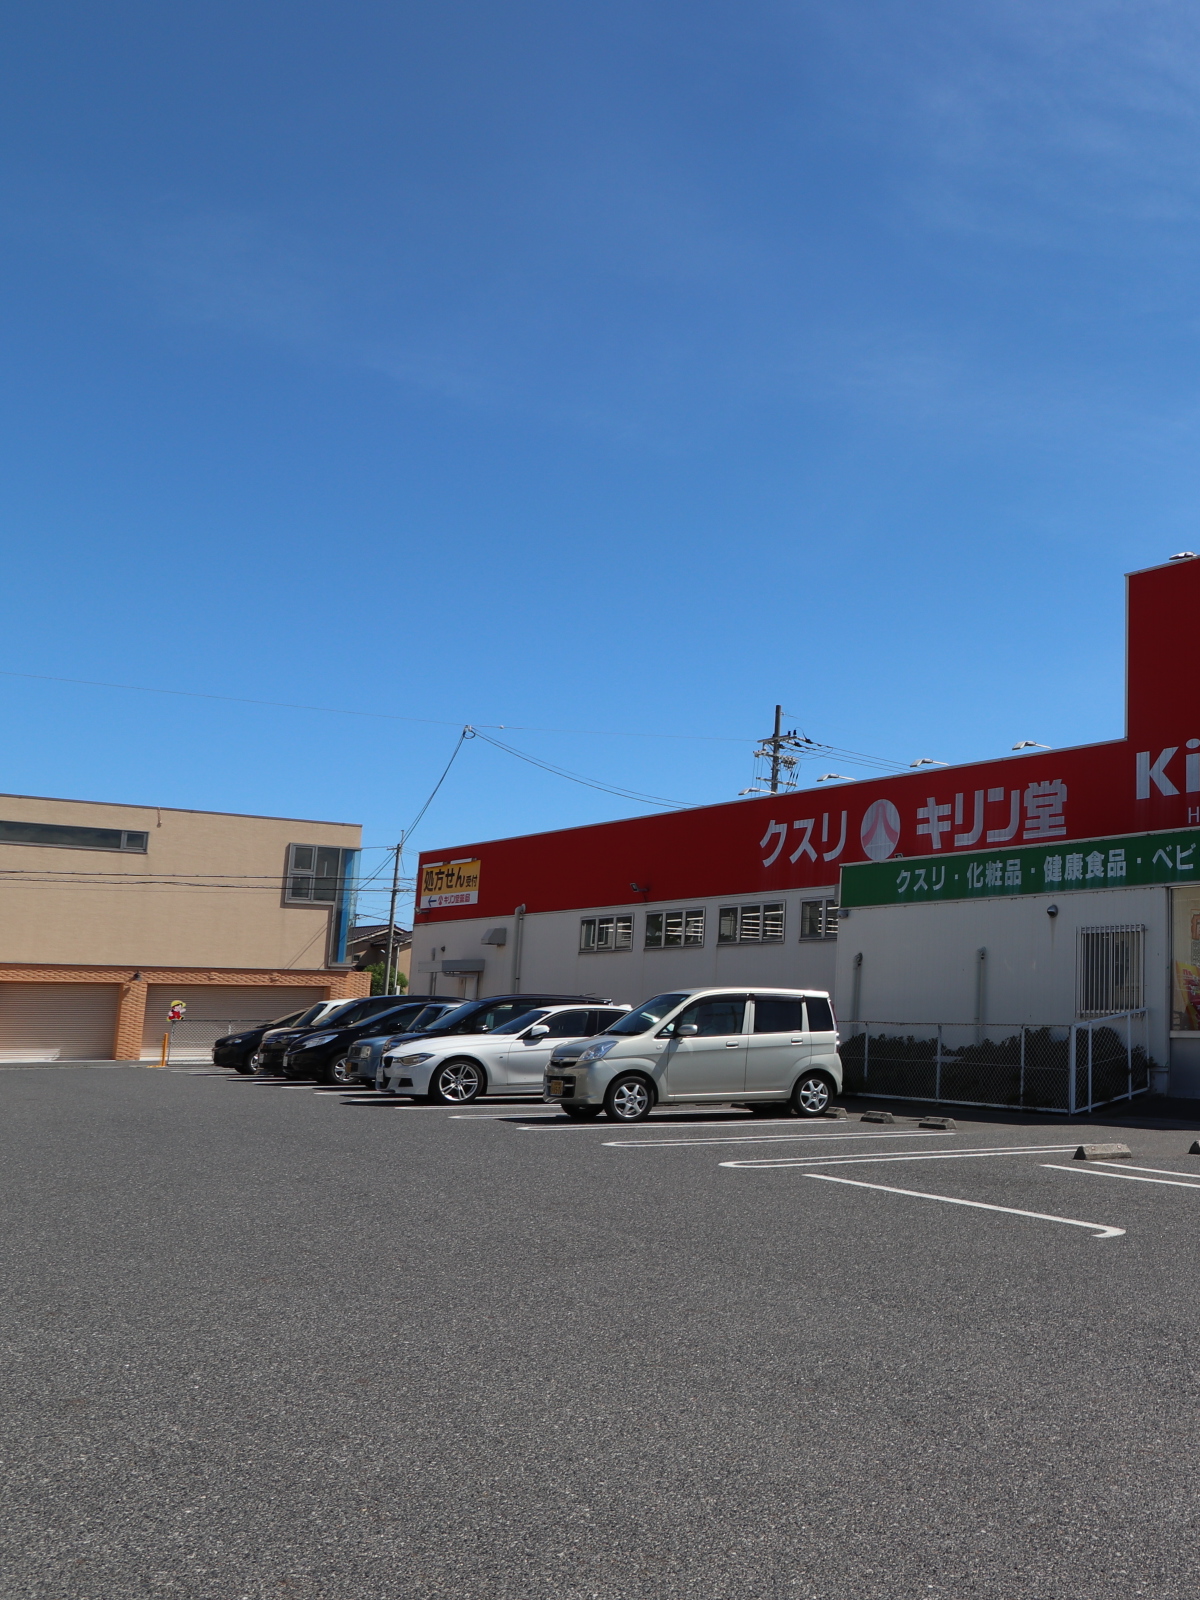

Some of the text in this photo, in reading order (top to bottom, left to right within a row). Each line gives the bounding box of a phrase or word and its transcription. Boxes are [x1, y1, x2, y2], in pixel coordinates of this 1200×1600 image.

[759, 779, 1068, 868] クスリ キリン堂
[424, 867, 478, 892] 処方せん受付
